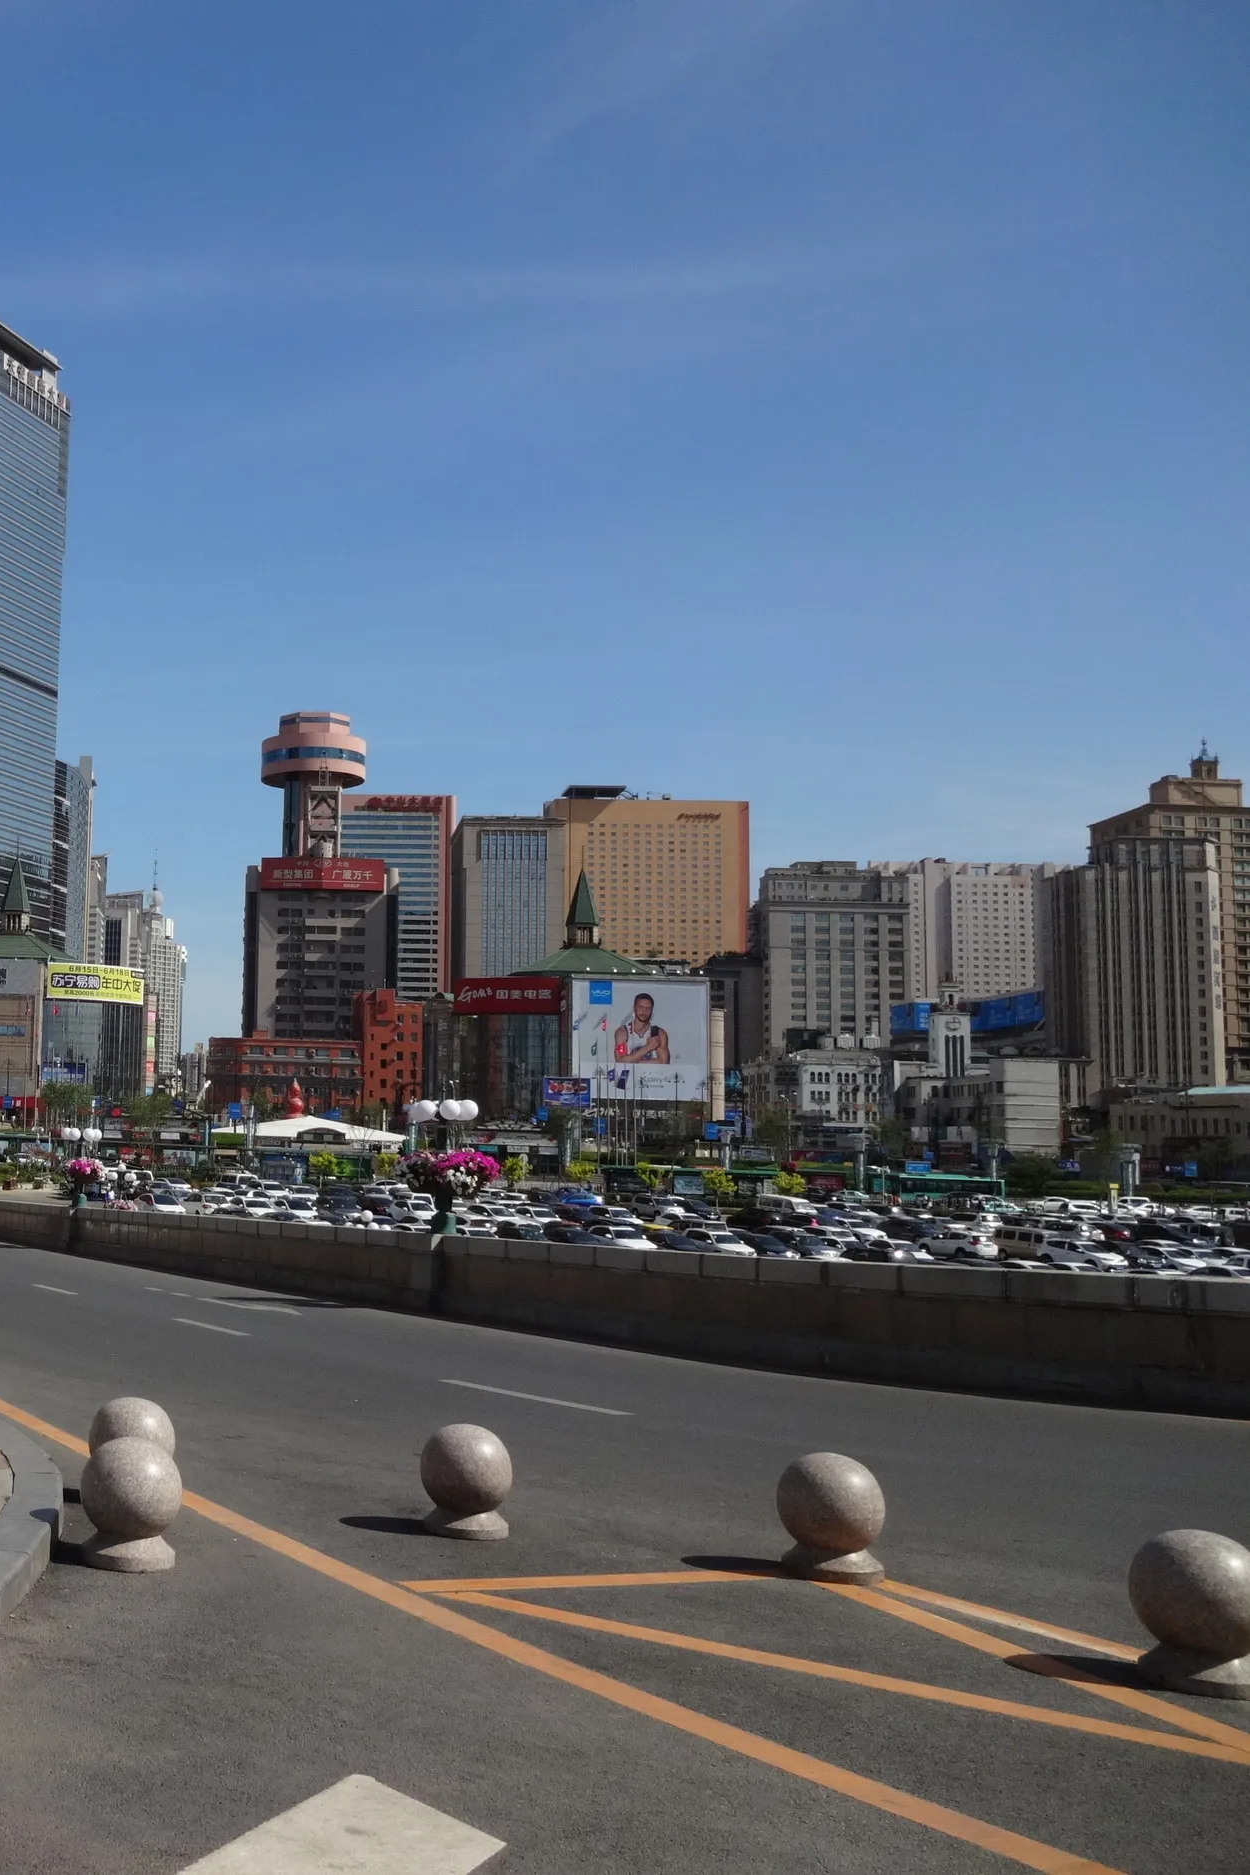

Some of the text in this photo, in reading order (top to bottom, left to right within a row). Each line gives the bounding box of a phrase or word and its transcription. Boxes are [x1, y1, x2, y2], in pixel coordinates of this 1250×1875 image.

[272, 869, 373, 880] 新型集团 广厦万千
[51, 973, 141, 994] 苏宁易购 年中大促
[496, 989, 552, 1000] 国美电器
